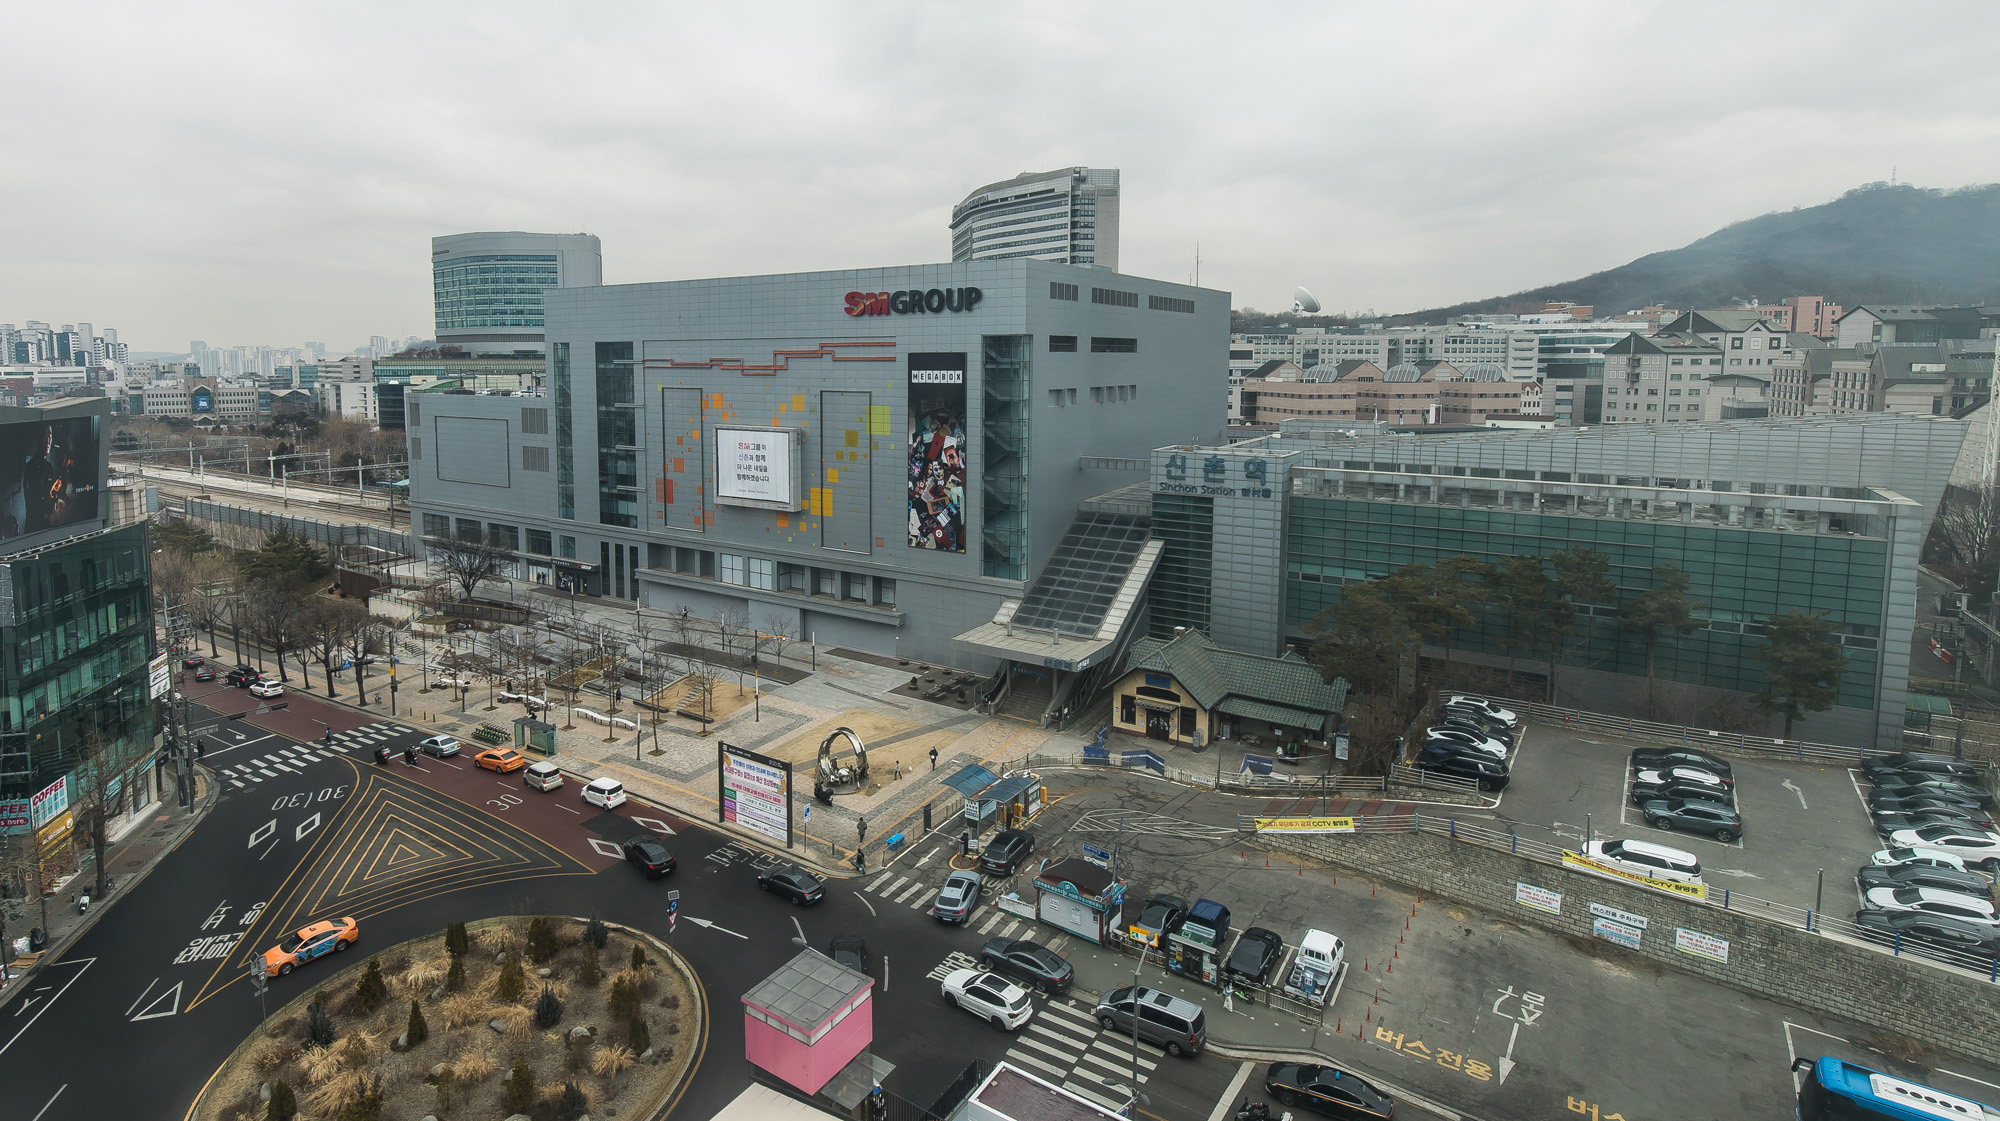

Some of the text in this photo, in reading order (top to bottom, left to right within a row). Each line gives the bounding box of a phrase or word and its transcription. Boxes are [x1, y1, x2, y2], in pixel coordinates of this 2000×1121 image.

[912, 372, 961, 381] MEGABOX
[738, 453, 766, 462] 신촌과 함께
[754, 465, 768, 473] 내일을
[1165, 454, 1267, 486] 신촌역
[1160, 482, 1198, 494] Sinchon
[1200, 485, 1236, 496] Station
[32, 777, 65, 806] COFFEE
[486, 794, 523, 811] 30
[1644, 878, 1672, 888] CCTV
[1592, 905, 1645, 926] 버스전용 주차구역
[1375, 1026, 1493, 1081] 버스전용
